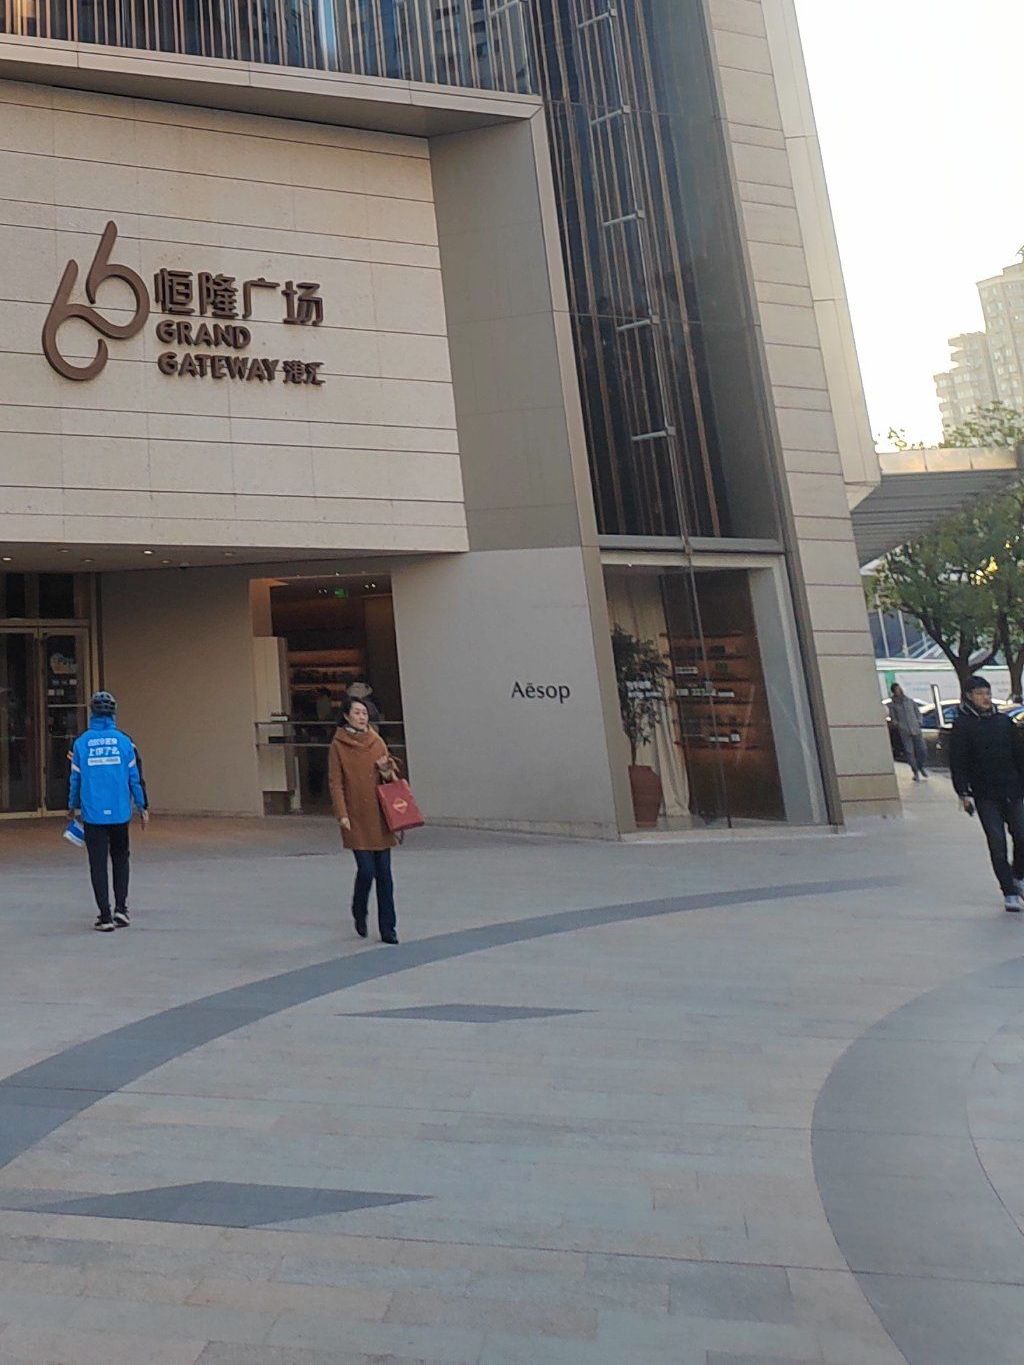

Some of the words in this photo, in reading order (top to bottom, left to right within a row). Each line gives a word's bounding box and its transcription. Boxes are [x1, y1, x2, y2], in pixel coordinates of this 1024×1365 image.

[153, 267, 325, 327] 恒隆广场
[155, 319, 252, 350] GRAND
[157, 350, 280, 382] GATEWAY
[282, 359, 326, 386] 港汇
